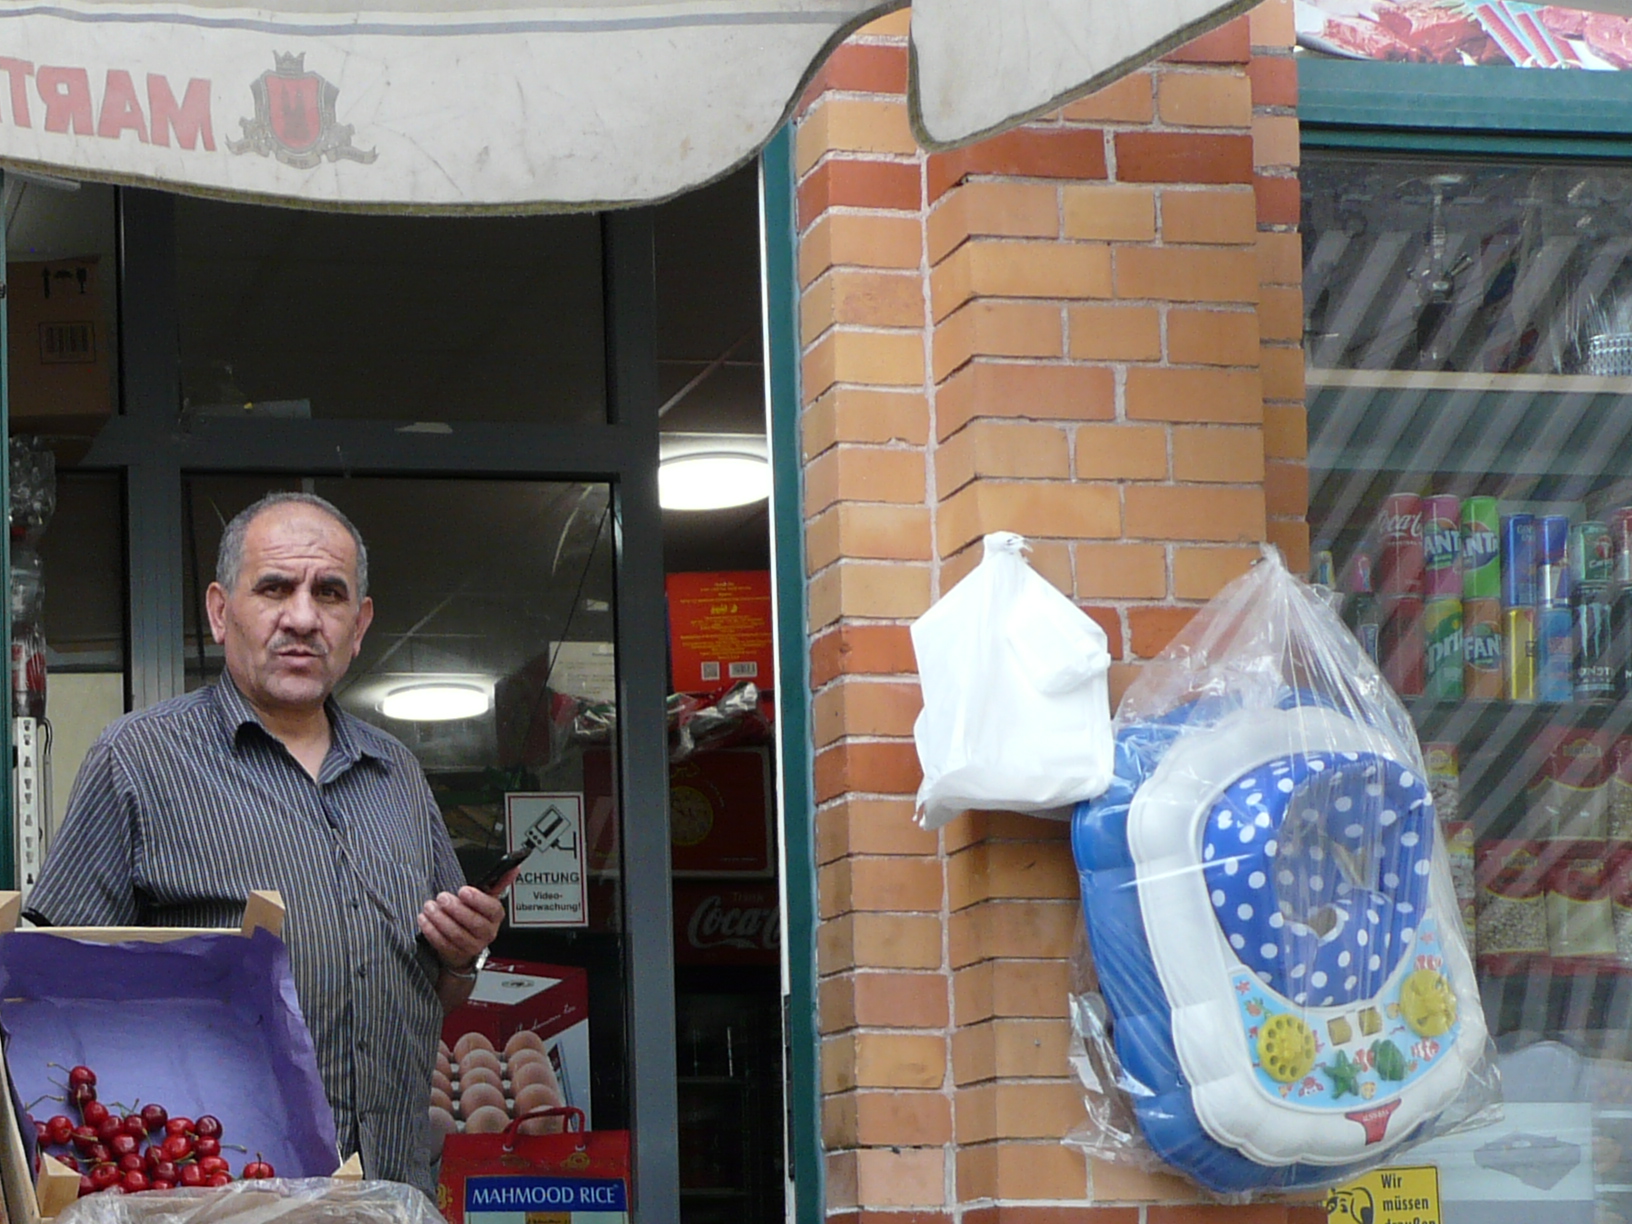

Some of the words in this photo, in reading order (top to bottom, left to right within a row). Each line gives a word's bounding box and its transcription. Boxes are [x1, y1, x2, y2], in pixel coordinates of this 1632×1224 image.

[515, 871, 579, 883] ACHTUNG
[532, 891, 563, 900] Video-
[515, 902, 581, 912] überwachung!
[1381, 1173, 1403, 1188] Wir
[472, 1186, 574, 1205] MAHMOOD
[579, 1186, 616, 1204] RICE
[1382, 1195, 1430, 1212] müssen
